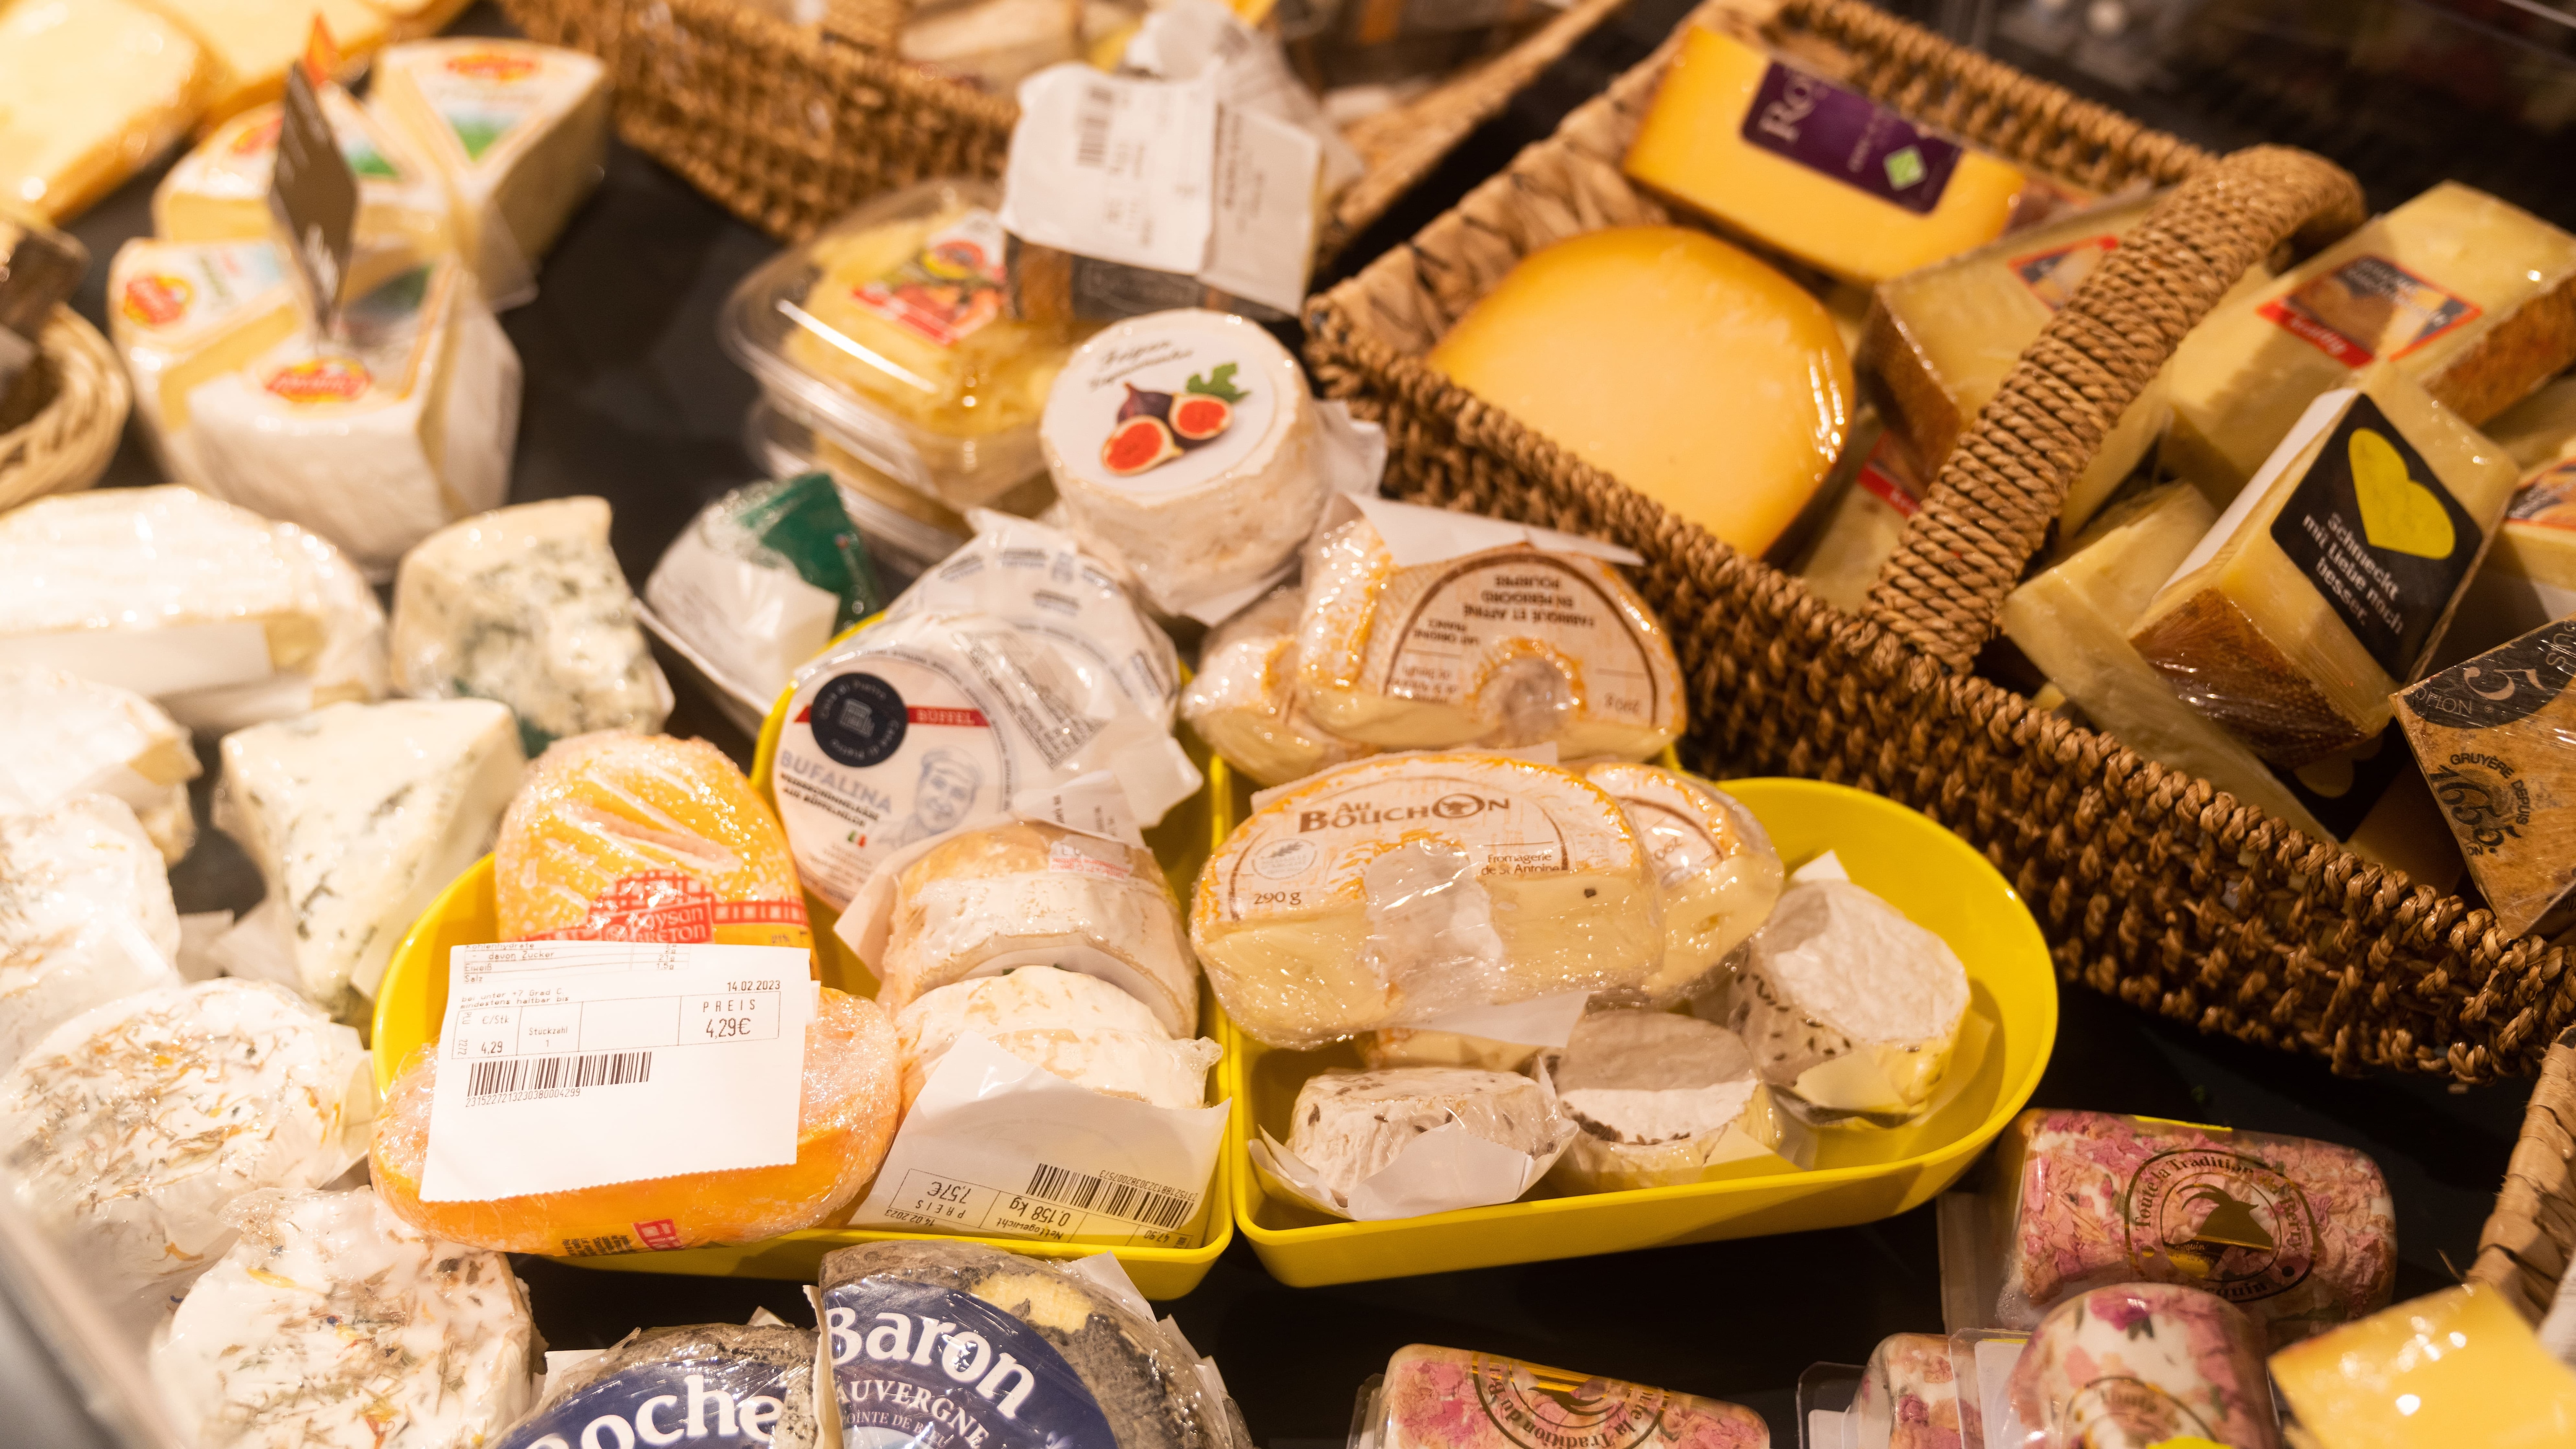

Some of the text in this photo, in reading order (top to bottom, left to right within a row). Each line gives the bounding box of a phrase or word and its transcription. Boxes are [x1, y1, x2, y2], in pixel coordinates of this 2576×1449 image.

[2327, 511, 2400, 602] Schmeckt
[2301, 513, 2405, 636] mit Liebe noch
[2315, 555, 2368, 627] besser.
[2450, 753, 2514, 779] GRUYÈRE
[781, 749, 891, 814] BUFALINA
[2511, 779, 2530, 825] DEPUIS
[1488, 854, 1552, 864] Fromagerie
[1481, 865, 1496, 875] de
[1514, 864, 1559, 874] Antoine
[1253, 891, 1301, 905] 290 g
[489, 951, 516, 960] davon
[522, 950, 554, 959] Zucker
[465, 963, 492, 972] Eiweiß
[465, 974, 483, 983] Salz
[727, 980, 781, 992] 14.02.2023
[461, 1000, 511, 1010] mindestens
[517, 997, 552, 1005] haltbar
[482, 1015, 510, 1025] €/Stk
[706, 1018, 751, 1039] 4,29€
[529, 1026, 568, 1035] Stückzahl
[457, 1039, 468, 1055] 2272
[481, 1041, 503, 1055] 4,29
[927, 1181, 972, 1204] 7,57€
[1009, 1196, 1071, 1226] 0,158 kg
[2135, 1182, 2159, 1231] Toute
[2156, 1170, 2171, 1182] la
[2166, 1154, 2253, 1175] Tradition
[2279, 1196, 2303, 1253] Berry
[885, 1209, 936, 1226] 14.02.2023
[996, 1218, 1064, 1240] Nettogewicht
[1143, 1229, 1170, 1243] 47,90
[825, 1306, 1035, 1420] Baron
[847, 1411, 889, 1424] OINTE
[892, 1414, 909, 1427] DE
[1500, 1397, 1523, 1426] du
[1614, 1419, 1636, 1438] la
